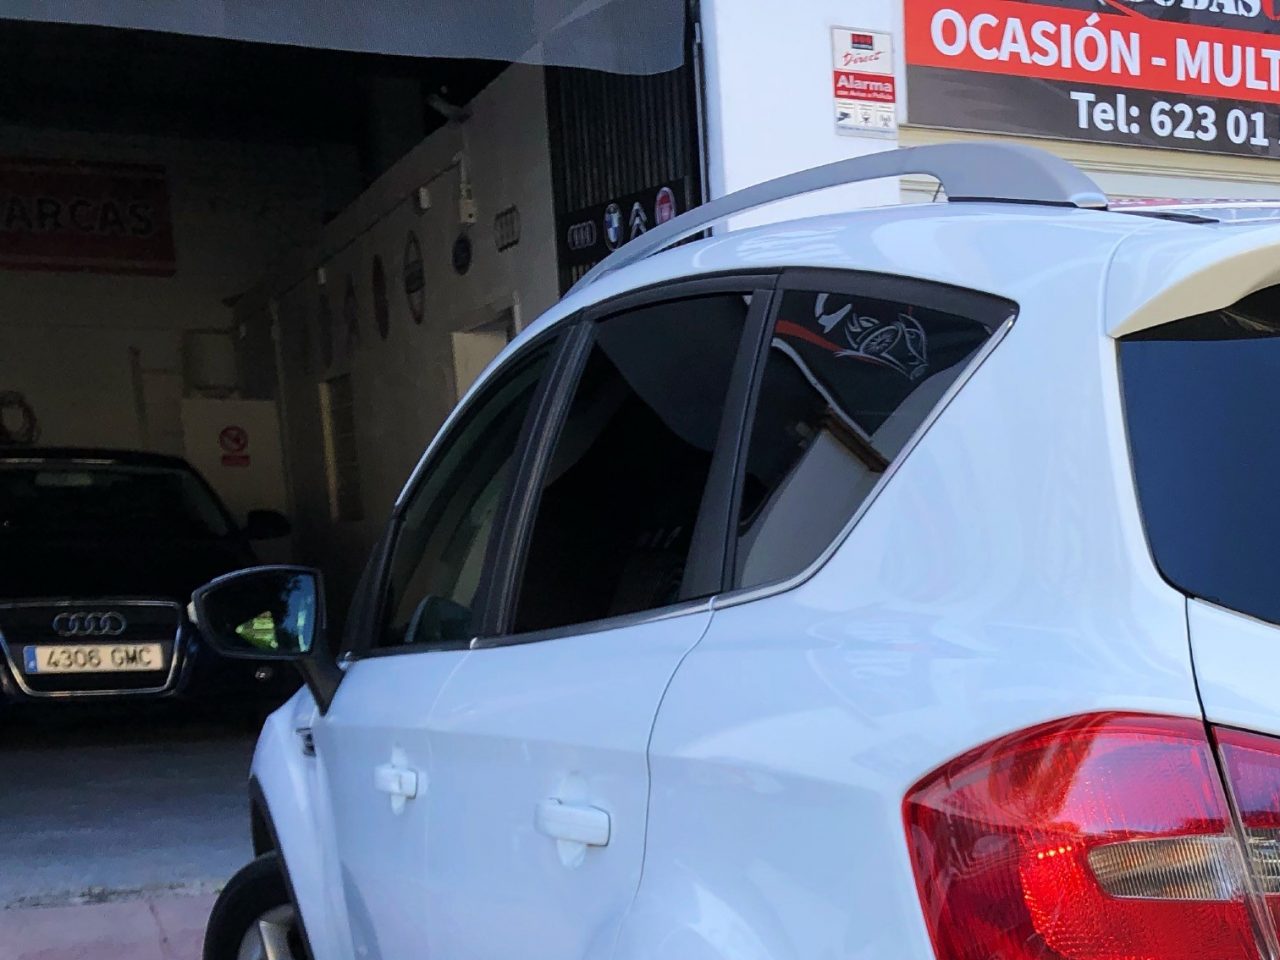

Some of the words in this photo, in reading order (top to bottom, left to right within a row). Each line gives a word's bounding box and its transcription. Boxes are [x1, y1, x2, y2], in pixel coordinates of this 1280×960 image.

[930, 8, 1141, 76] OCASIÓN
[1151, 56, 1167, 67] -
[837, 74, 893, 92] Alarma
[1069, 91, 1141, 135] Tel:
[1150, 101, 1218, 142] 623
[1226, 108, 1270, 147] 01
[111, 647, 152, 667] GMC
